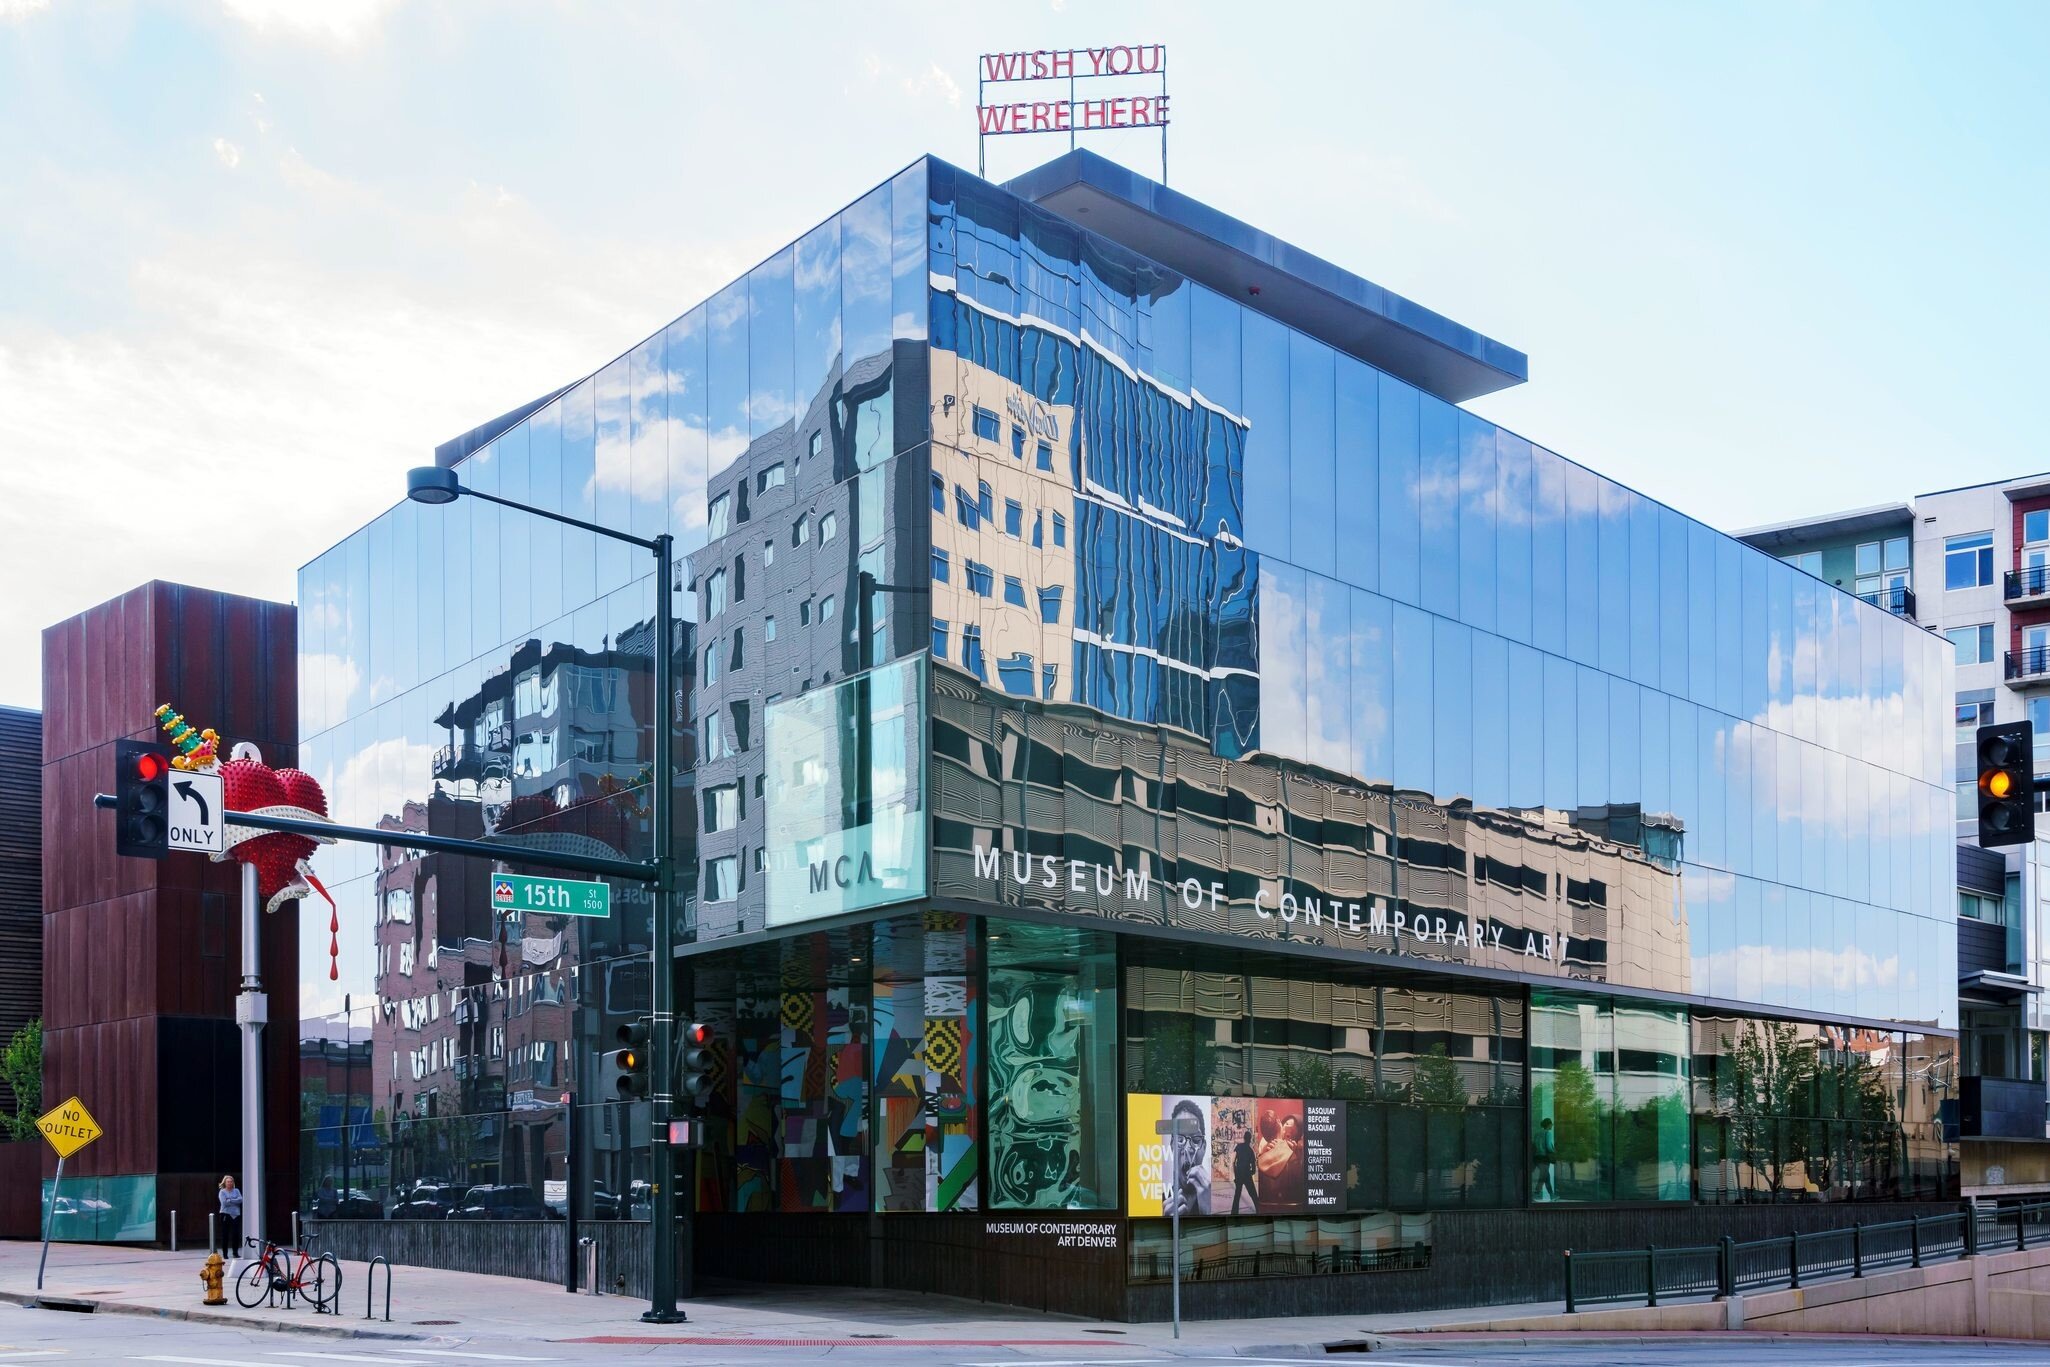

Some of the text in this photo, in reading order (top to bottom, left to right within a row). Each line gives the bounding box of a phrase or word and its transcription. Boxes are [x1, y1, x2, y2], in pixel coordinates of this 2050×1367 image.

[985, 43, 1159, 81] WISH YOU
[976, 95, 1170, 134] WERE HERE
[170, 827, 213, 844] ONLY
[809, 850, 873, 894] MCA
[524, 883, 570, 908] 15th
[589, 889, 597, 899] St
[583, 899, 603, 910] 1500
[974, 844, 1570, 962] MUSEUM OF CONTEMPORARY ART
[62, 1110, 80, 1121] NO
[1307, 1107, 1335, 1115] BASQUIAT
[1307, 1115, 1330, 1124] BEFORE
[45, 1123, 93, 1139] OUTLET
[1307, 1123, 1336, 1132] BASQUIAT
[1307, 1139, 1324, 1147] WALL
[1307, 1147, 1333, 1156] WRITERS
[1307, 1156, 1332, 1164] GRAFFITI
[1139, 1163, 1162, 1181] ON
[1307, 1165, 1324, 1173] IN ITS
[1307, 1173, 1341, 1181] INNOCENCE
[1139, 1182, 1174, 1200] VIEW
[1307, 1188, 1324, 1197] RYAN
[1307, 1196, 1337, 1205] McGINLEY
[986, 1223, 1117, 1235] MUSEUM OF CONTEMPORARY
[1057, 1236, 1117, 1247] ART DENVER
